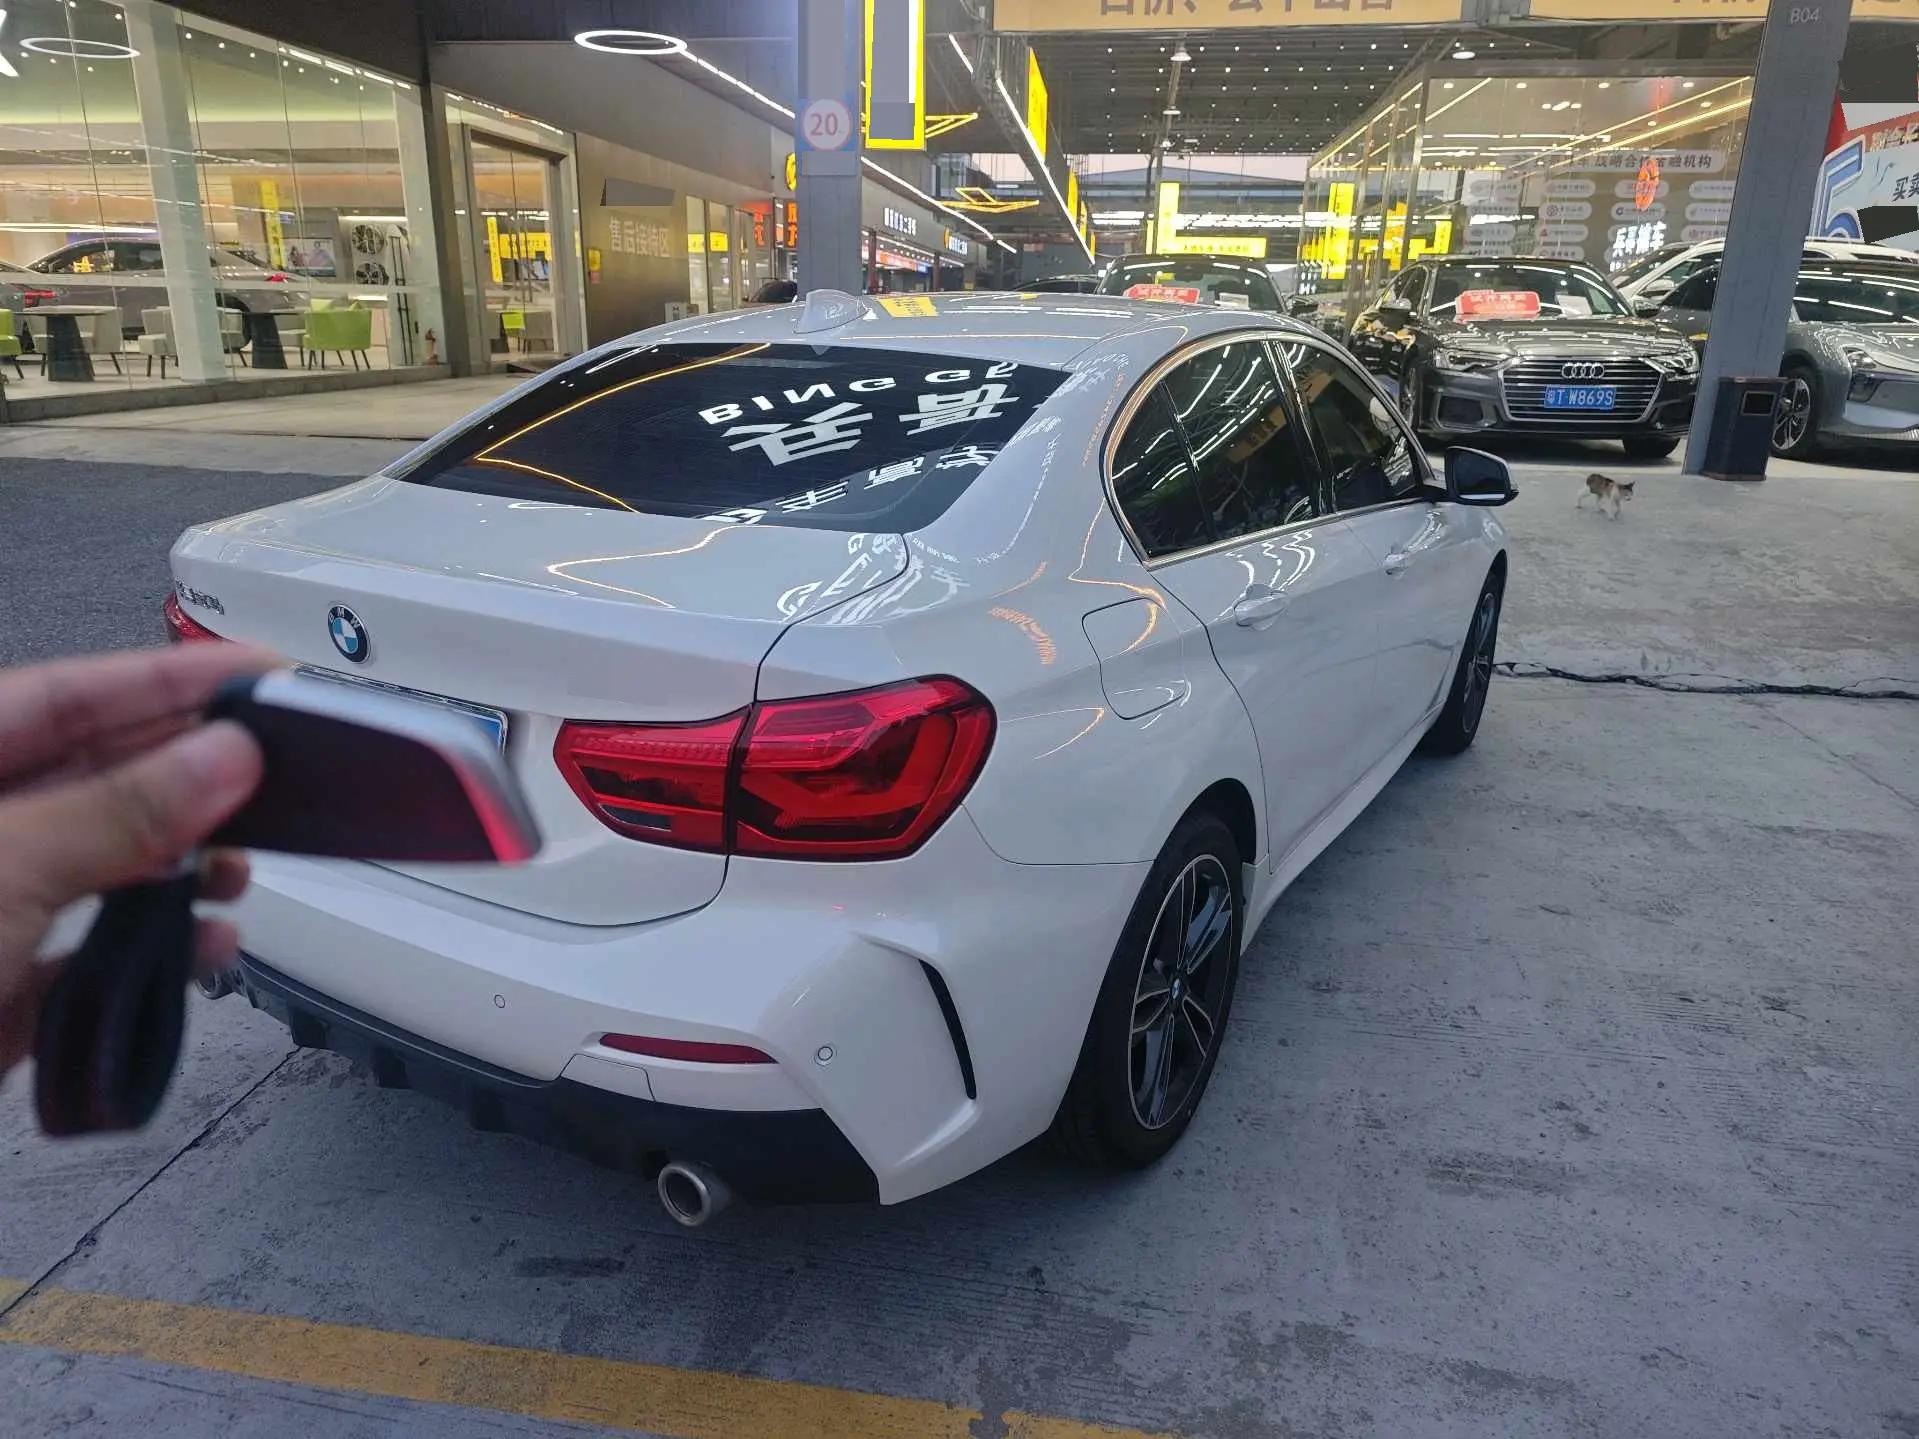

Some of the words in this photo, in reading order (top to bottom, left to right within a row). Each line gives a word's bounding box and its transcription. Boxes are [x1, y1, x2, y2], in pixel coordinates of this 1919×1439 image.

[1790, 7, 1822, 25] B04
[810, 113, 839, 136] 20
[608, 215, 671, 258] 售后接待区
[328, 606, 361, 629] BMW
